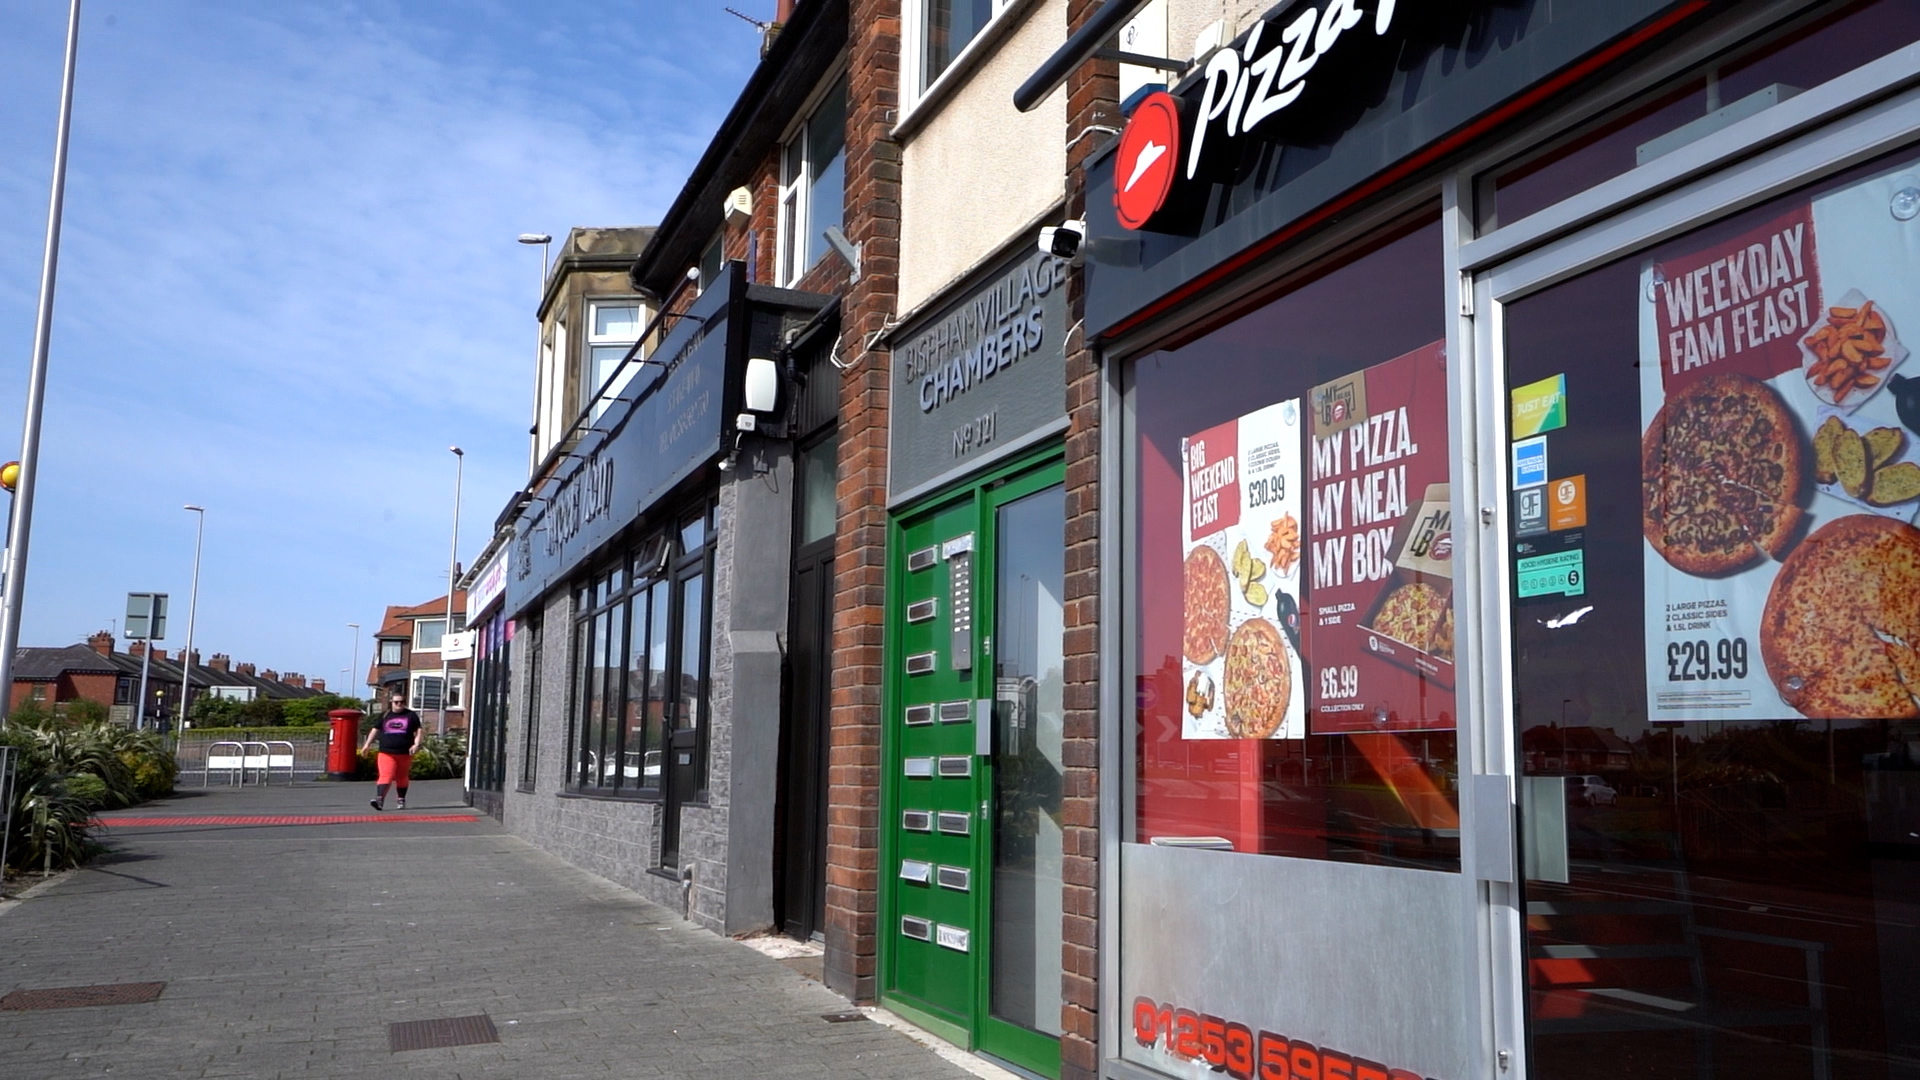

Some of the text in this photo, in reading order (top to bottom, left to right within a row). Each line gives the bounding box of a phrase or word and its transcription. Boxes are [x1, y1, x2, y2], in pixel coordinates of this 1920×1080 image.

[1664, 222, 1805, 329] WEEKDAY
[1668, 279, 1810, 376] FAM FEAST
[919, 305, 1043, 413] CHAMBERS
[1516, 398, 1540, 417] JUST
[1542, 391, 1562, 408] EAT
[1190, 439, 1206, 472] BIG
[1311, 406, 1418, 482] MY PIZZA.
[1191, 456, 1236, 500] WEEKEND
[1249, 473, 1285, 508] £30.99
[1192, 492, 1219, 530] FEAST
[1312, 464, 1409, 536] MY MEAL
[1429, 510, 1451, 531] M
[1312, 526, 1394, 590] MY BOX
[1520, 553, 1580, 569] FOOD HYGIENE RATING
[1570, 571, 1578, 584] 5
[1318, 603, 1356, 615] SMALL PIZZA
[1318, 618, 1324, 626] &
[1328, 615, 1342, 625] SIDE
[1665, 599, 1728, 612] 2 LARGE PIZZAS,
[1665, 609, 1728, 622] 2 CLASSIC SIDES
[1666, 621, 1711, 632] & 1.5L DRINK
[1667, 637, 1748, 682] £29.99
[1320, 664, 1359, 699] £6.99
[1320, 702, 1365, 713] COLLECTION ONLY
[1133, 997, 1255, 1080] 01253
